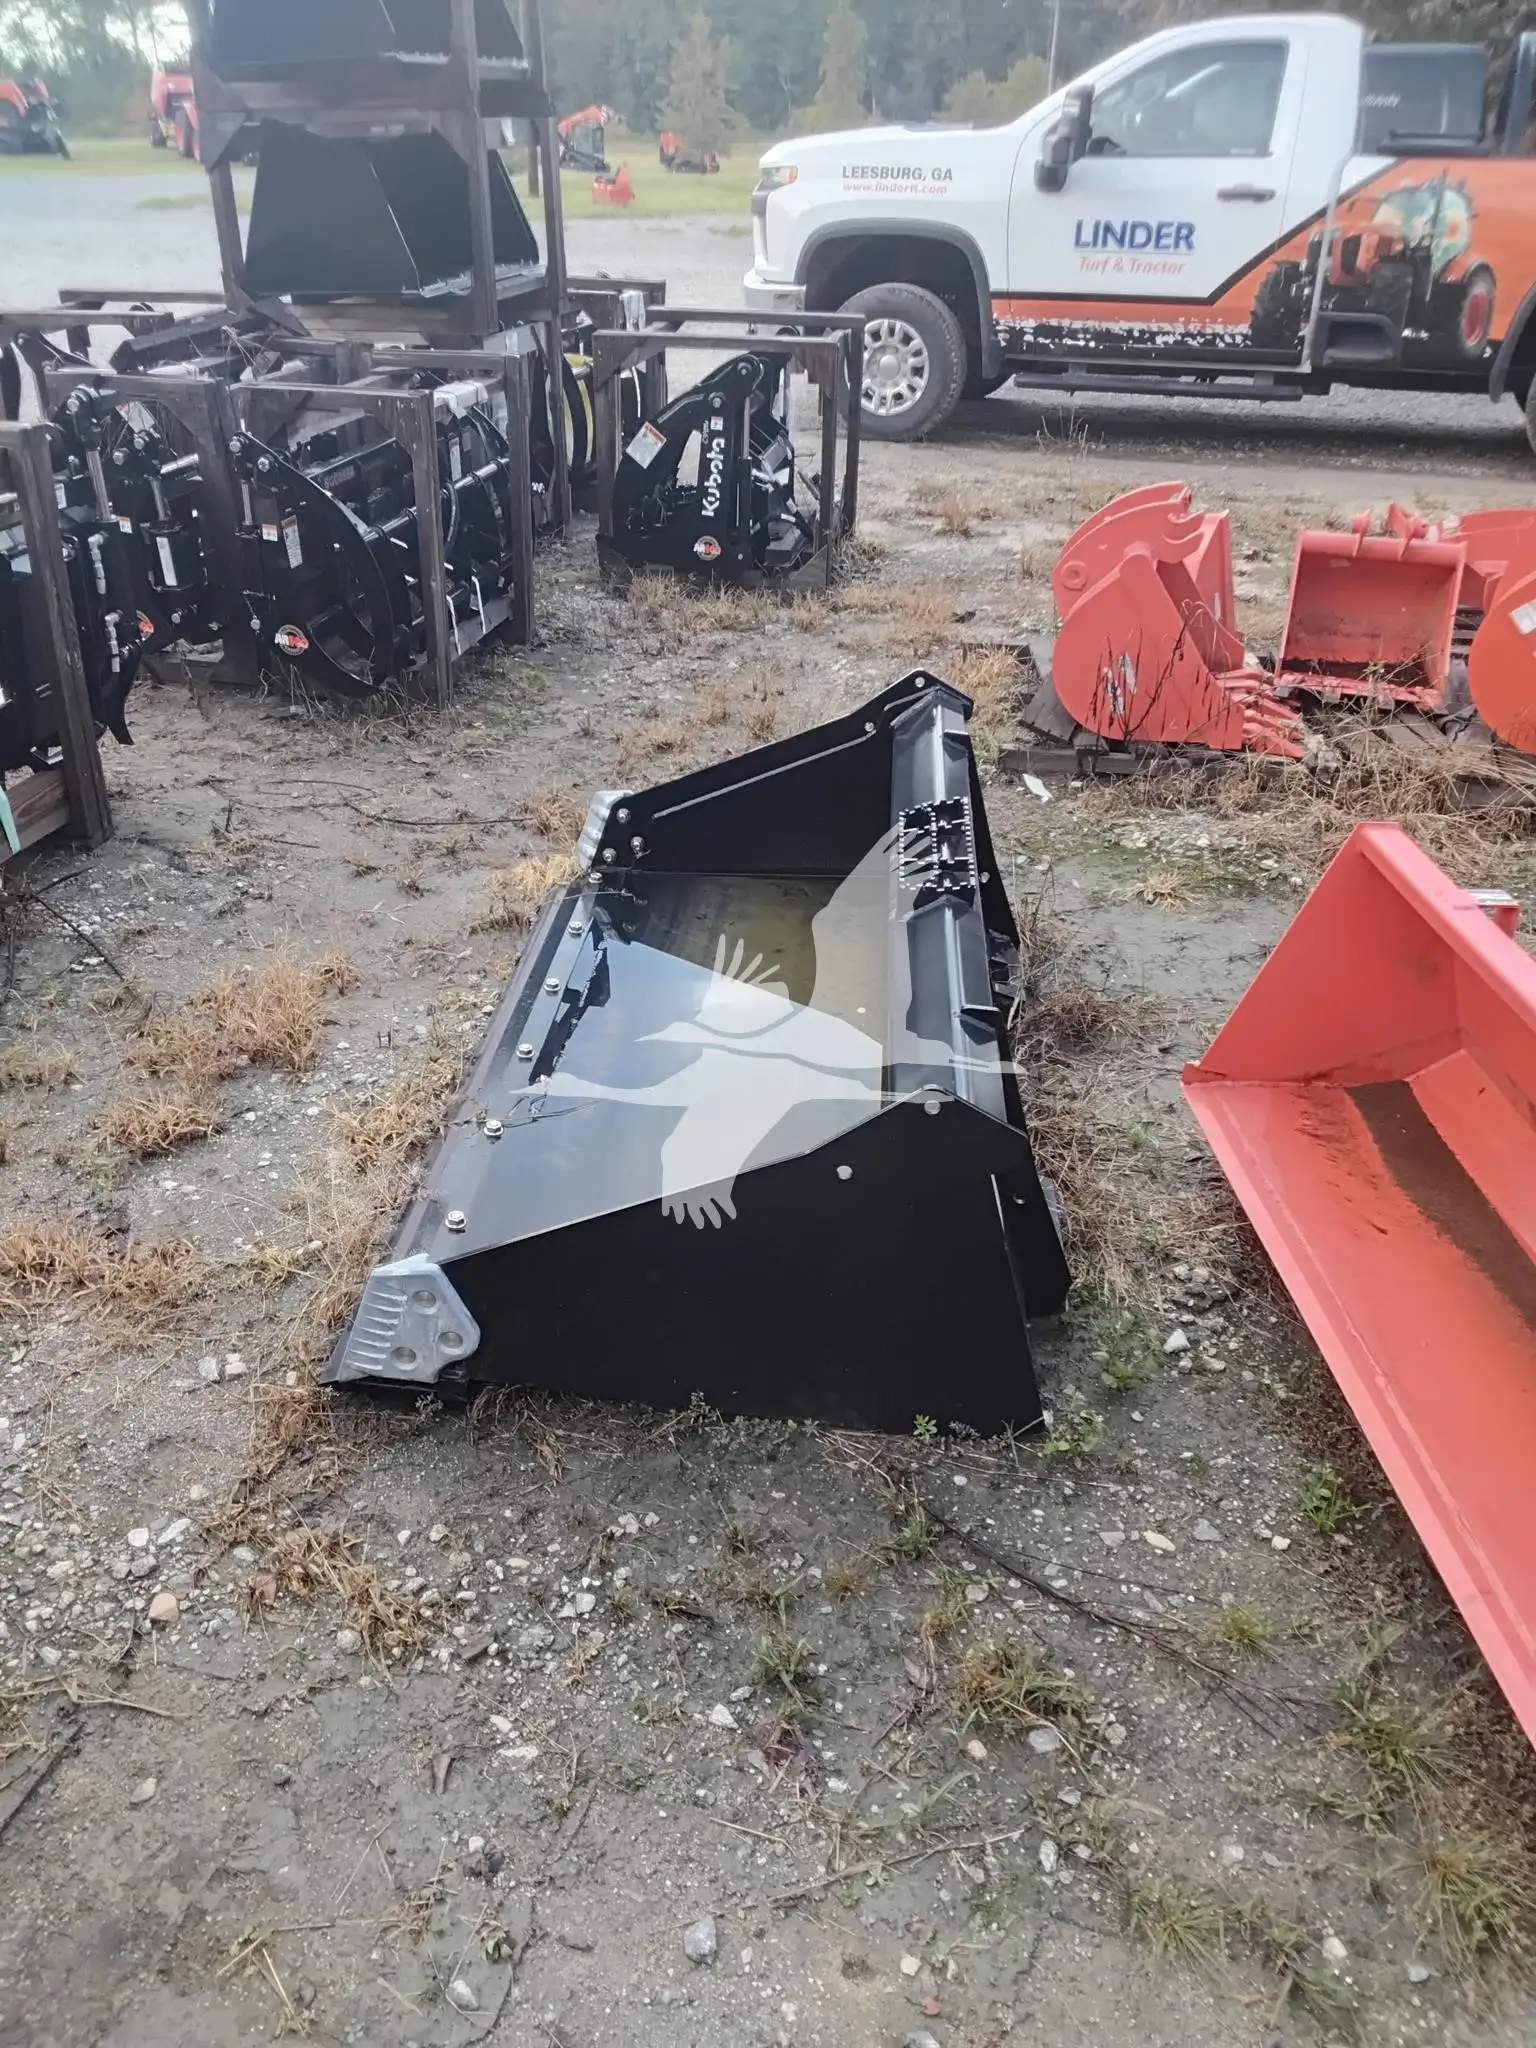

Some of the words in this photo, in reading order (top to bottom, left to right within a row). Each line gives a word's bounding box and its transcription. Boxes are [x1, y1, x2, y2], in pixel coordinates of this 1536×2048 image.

[842, 166, 926, 181] LEESBURG,
[931, 168, 953, 181] GA
[1074, 219, 1196, 251] LINDER
[1079, 256, 1110, 275] Turf
[1112, 257, 1123, 273] &
[1129, 258, 1186, 275] Tractor
[701, 437, 725, 517] Kubota
